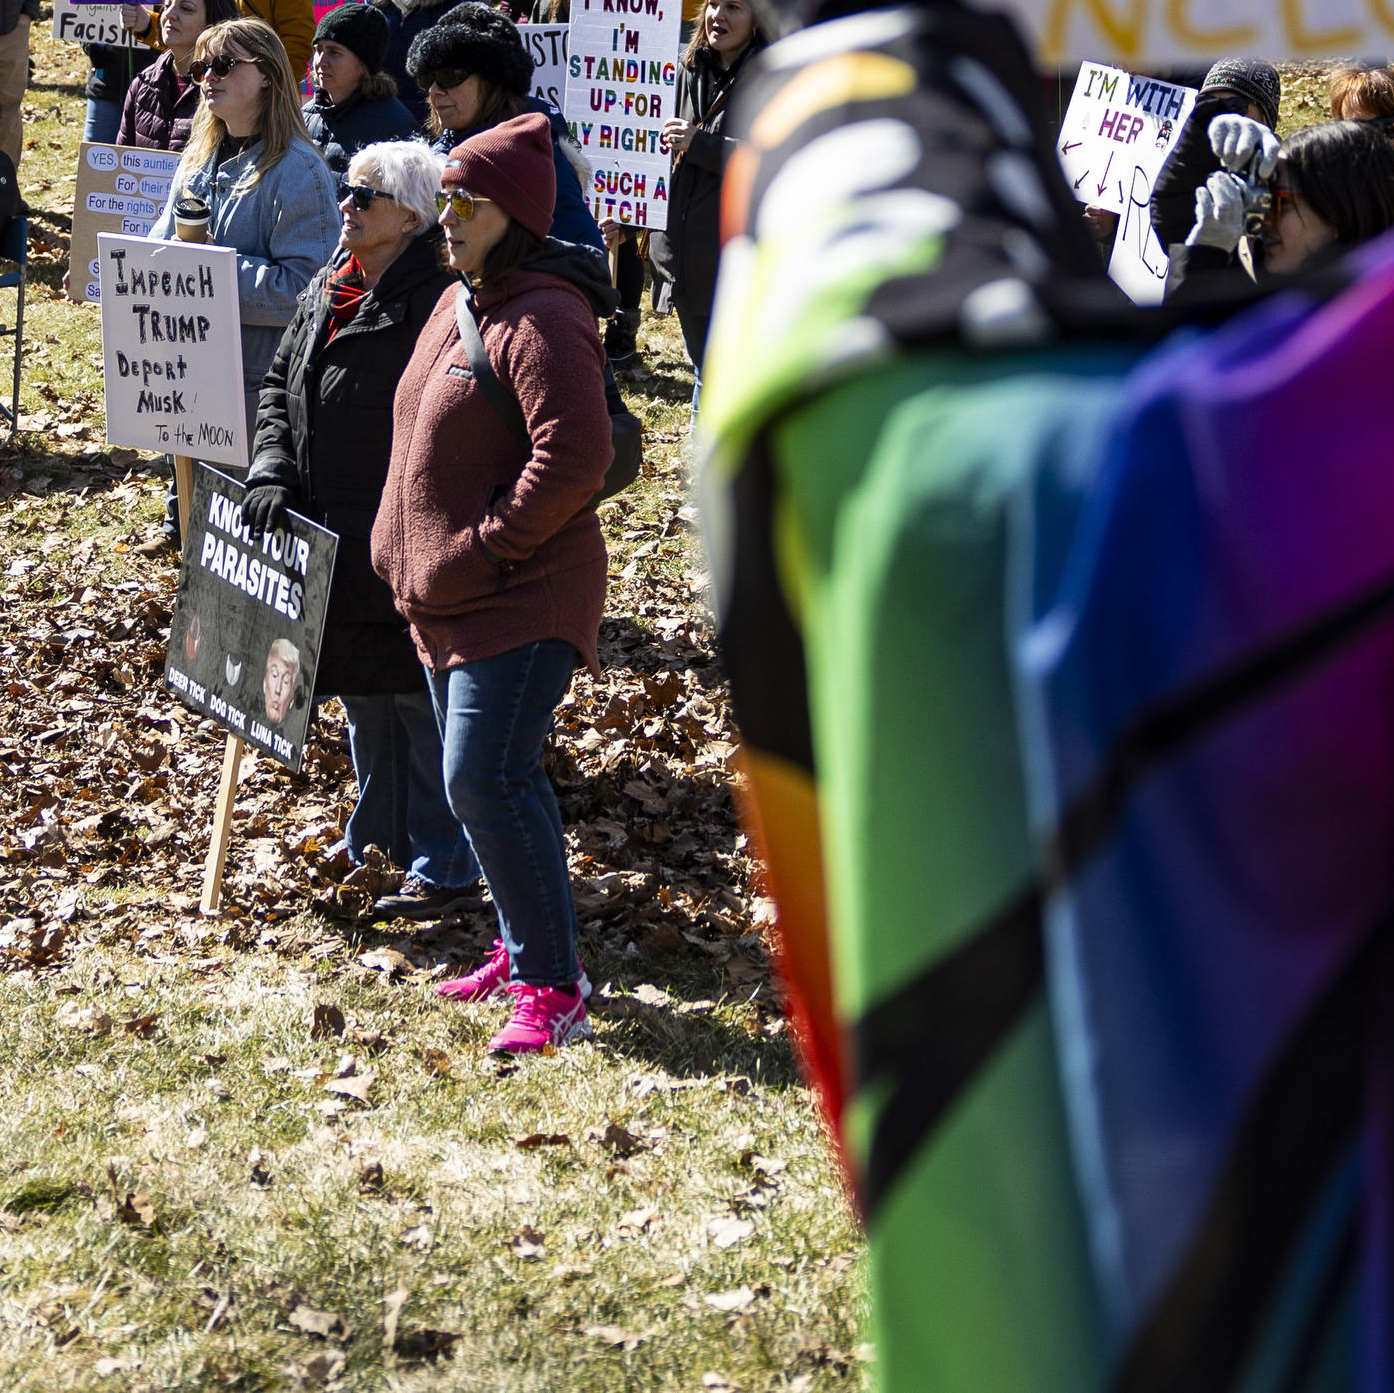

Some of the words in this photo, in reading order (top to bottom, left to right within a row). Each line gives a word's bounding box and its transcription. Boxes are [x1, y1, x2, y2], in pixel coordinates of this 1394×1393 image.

[612, 23, 640, 54] I'M
[569, 54, 675, 86] STANDING
[590, 87, 616, 113] UP
[624, 92, 662, 118] FOR
[1083, 69, 1120, 103] I'M
[1125, 76, 1186, 120] WITH
[567, 119, 594, 146] MY
[600, 124, 670, 156] RIGHTS
[1097, 108, 1144, 144] HER
[92, 153, 117, 167] YES,
[123, 155, 141, 168] this
[143, 157, 174, 171] auntie
[118, 177, 136, 191] For
[141, 182, 164, 194] their
[593, 169, 647, 198] SUCH
[653, 176, 668, 201] A
[89, 195, 106, 209] For
[108, 198, 124, 211] the
[126, 200, 155, 216] rights
[585, 196, 648, 226] ITCH
[122, 219, 140, 233] For
[208, 491, 254, 547] KNO
[262, 527, 310, 576] YOUR
[200, 530, 304, 621] PARASITES
[169, 667, 188, 692] DEER
[188, 679, 206, 705] TICK
[210, 693, 226, 719] DOG
[227, 707, 245, 731] TICK
[250, 720, 272, 747] LUNA
[273, 732, 293, 760] TICK
